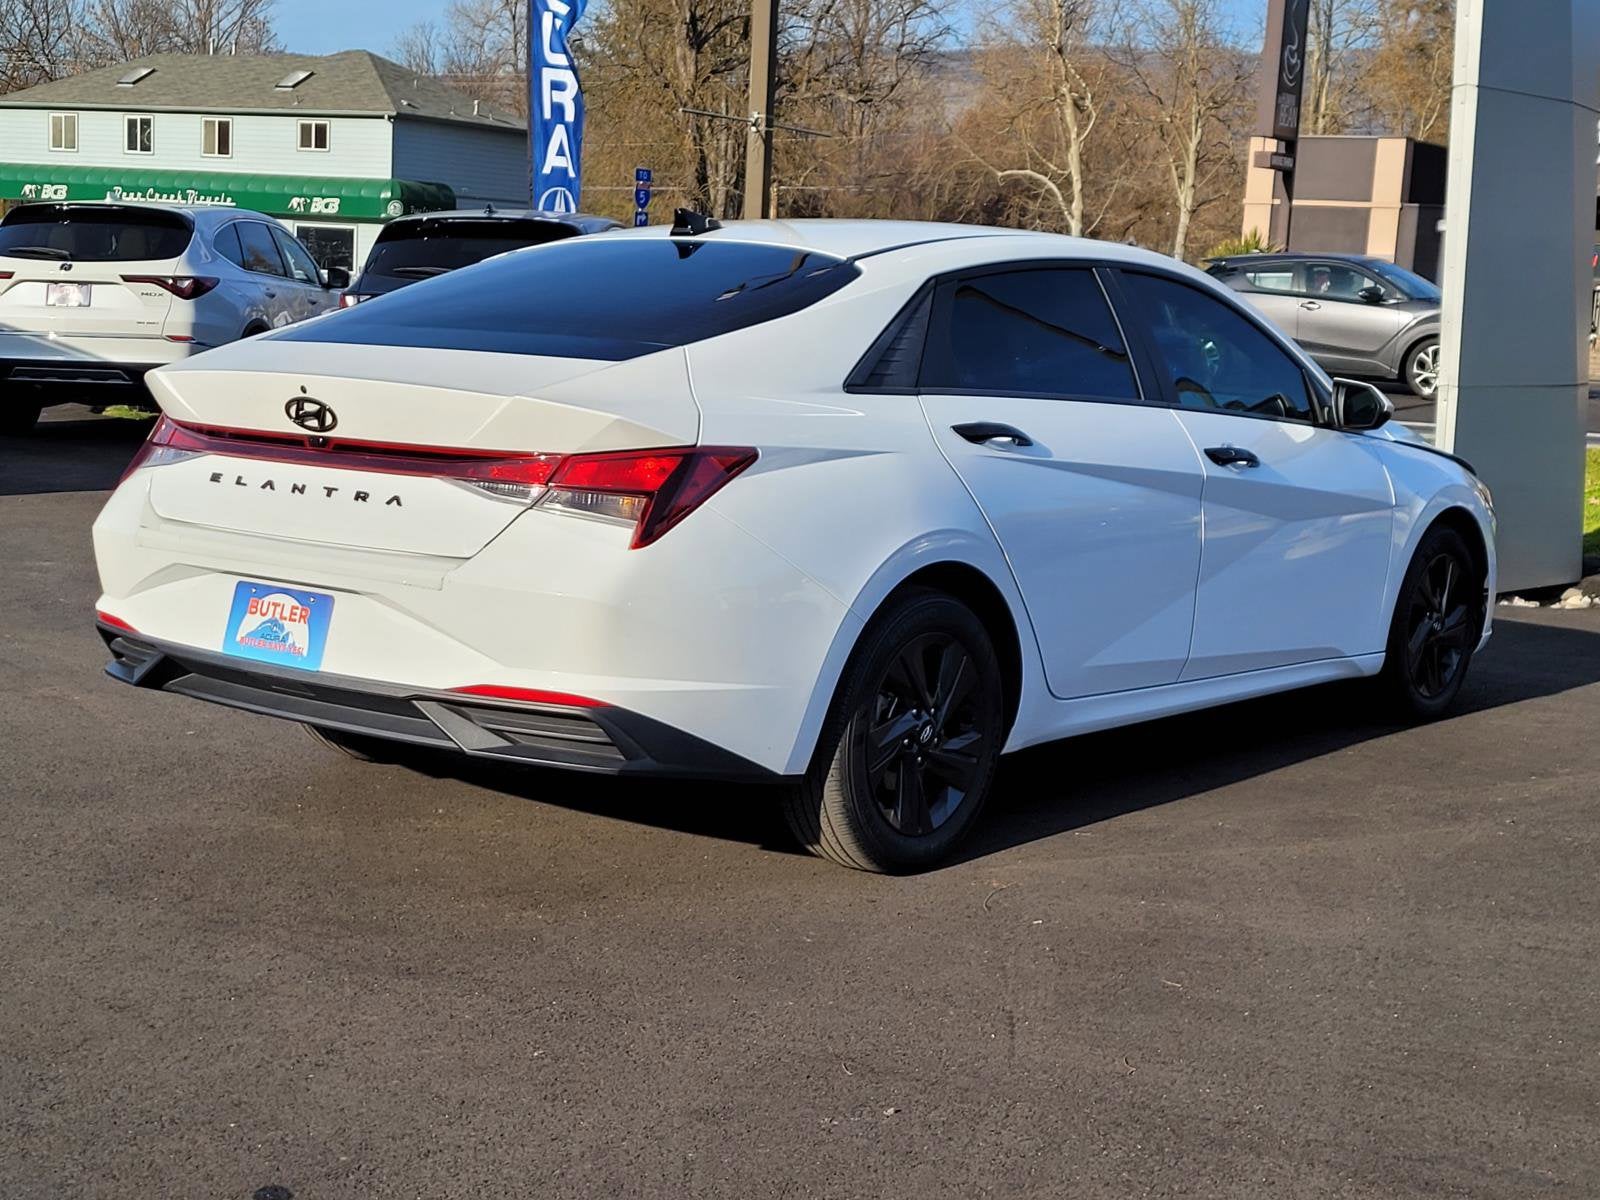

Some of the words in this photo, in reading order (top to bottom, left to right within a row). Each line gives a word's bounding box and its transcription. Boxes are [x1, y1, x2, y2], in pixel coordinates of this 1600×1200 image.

[639, 170, 648, 180] TO
[639, 190, 646, 204] 5
[209, 472, 402, 507] ELANTRA
[247, 597, 310, 625] BUTLER
